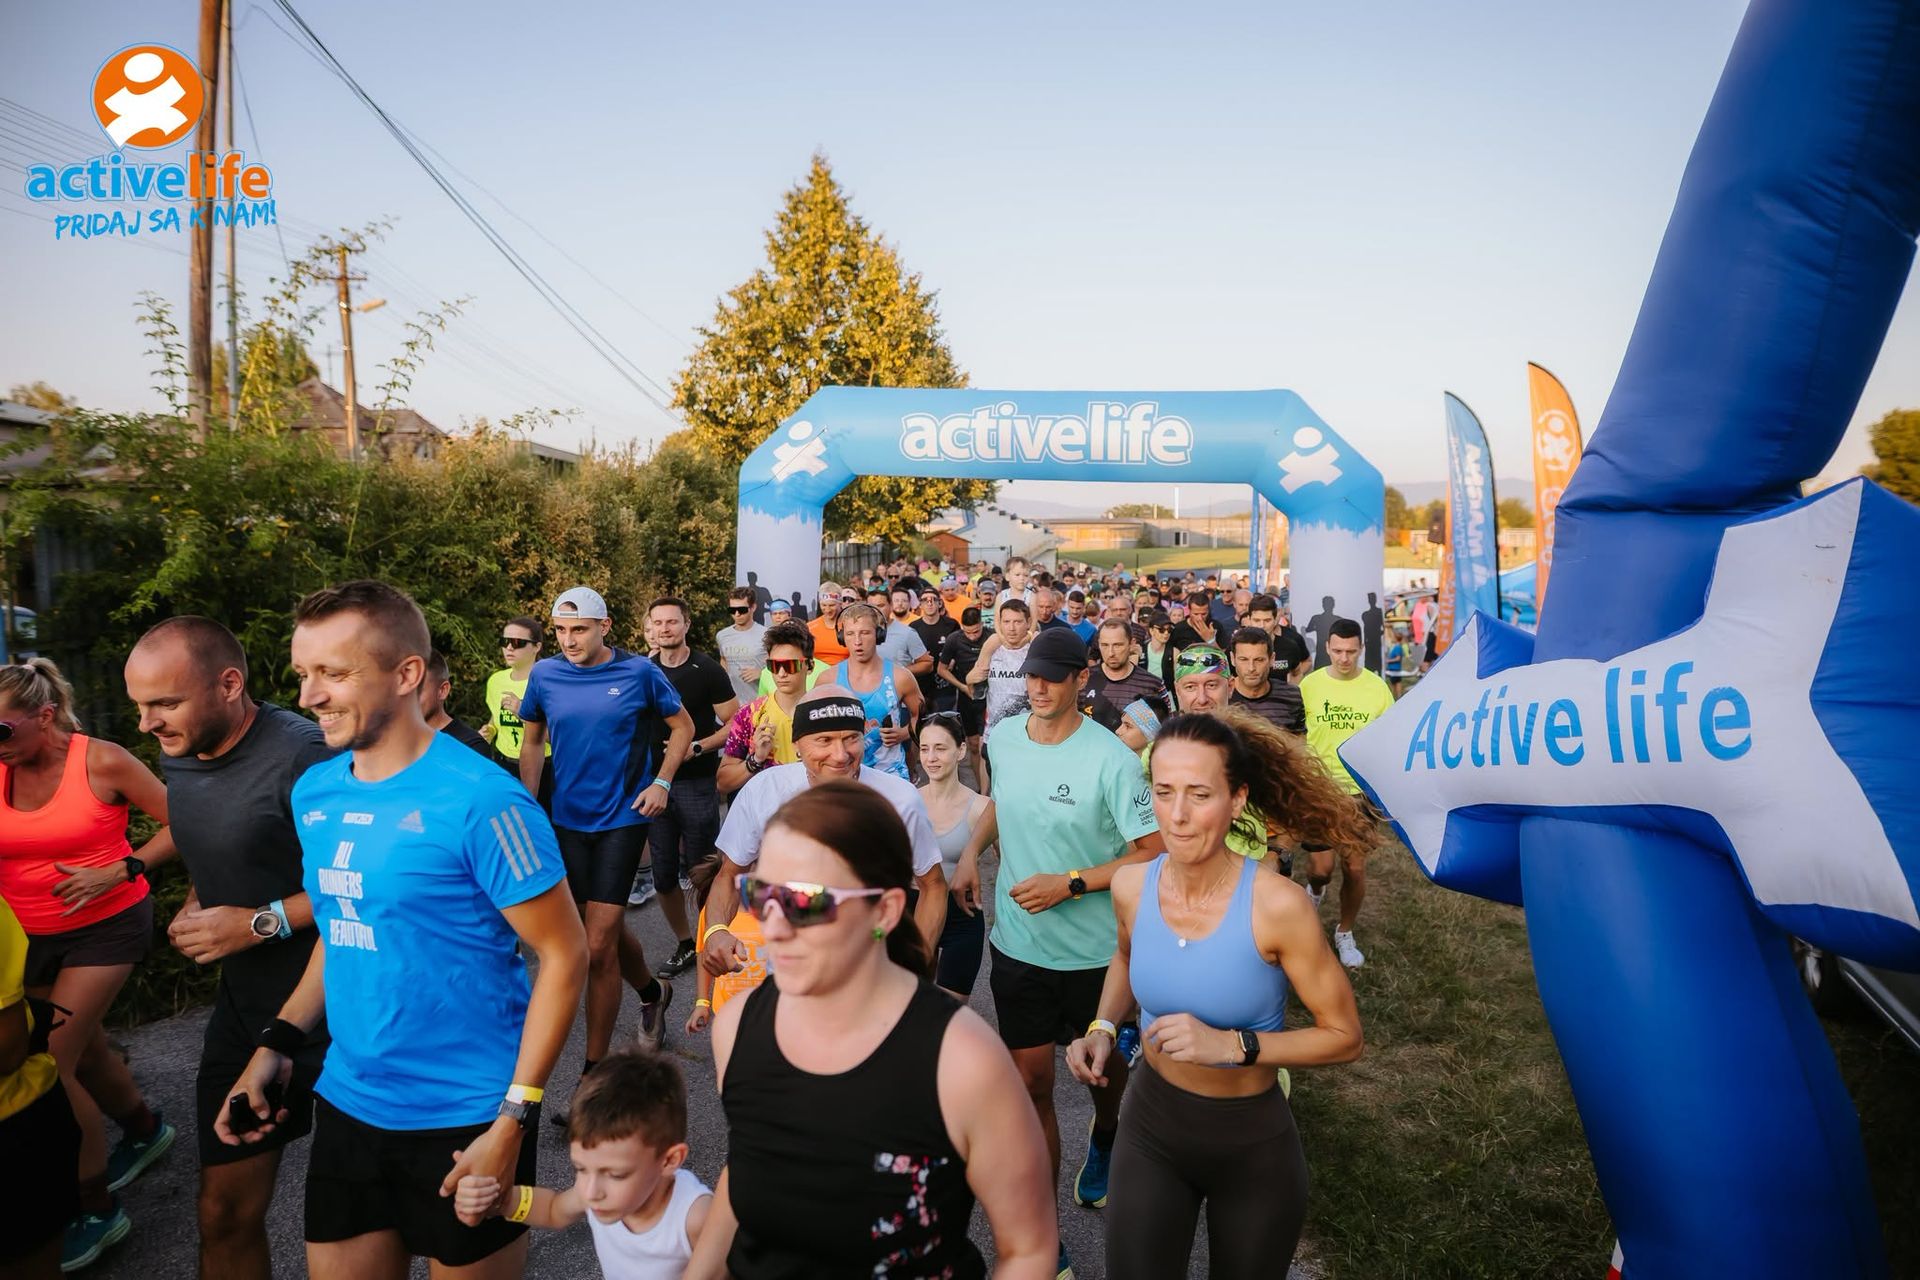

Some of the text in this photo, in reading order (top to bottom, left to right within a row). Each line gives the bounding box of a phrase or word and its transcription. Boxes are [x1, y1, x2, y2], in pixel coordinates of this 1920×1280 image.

[900, 402, 1193, 465] activelife
[1316, 712, 1370, 723] runway
[1330, 721, 1355, 730] RUN
[1404, 661, 1752, 772] Active life
[332, 841, 355, 869] ALL
[318, 867, 363, 900] RUNNERS
